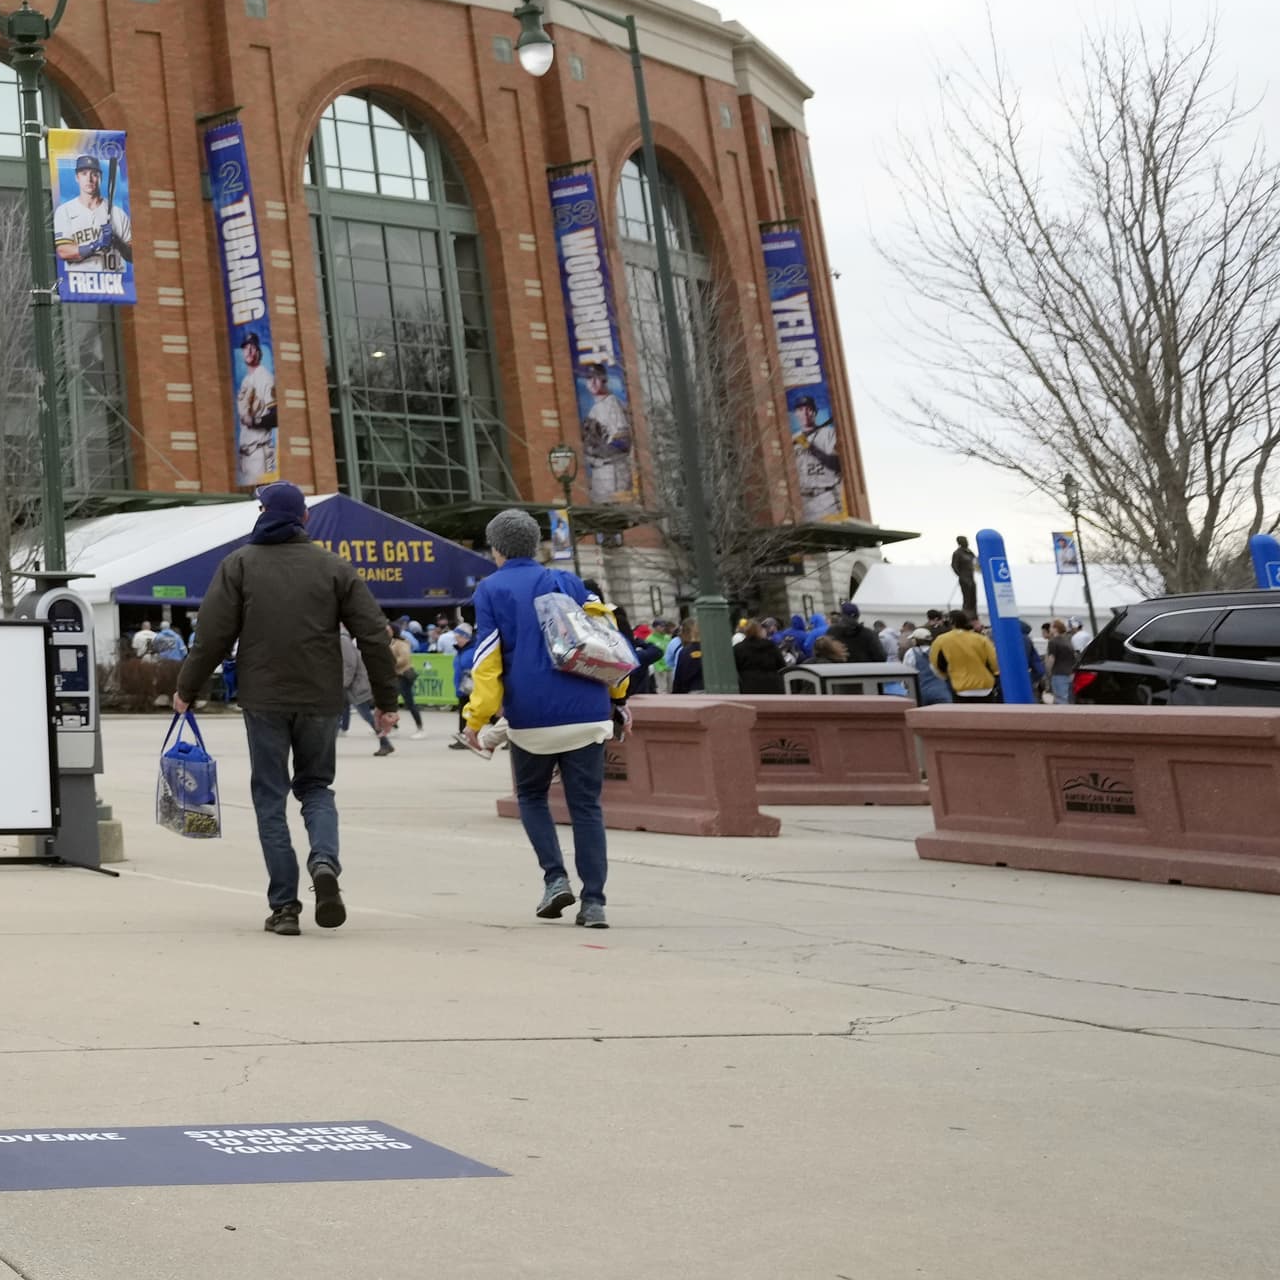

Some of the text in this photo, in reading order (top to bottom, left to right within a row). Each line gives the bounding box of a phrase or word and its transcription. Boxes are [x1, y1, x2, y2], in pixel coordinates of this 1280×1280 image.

[219, 160, 245, 194] 2
[554, 199, 598, 231] 53
[102, 251, 117, 271] 10
[219, 193, 266, 327] TURANG
[68, 271, 126, 295] FRELICK
[560, 226, 616, 367] WOODRUFF
[771, 292, 823, 388] YELICH
[382, 540, 436, 563] GATE
[184, 1126, 379, 1139] STAND HERE
[196, 1133, 397, 1147] TO CAPTURE
[212, 1142, 413, 1155] YOUR PHOTO
